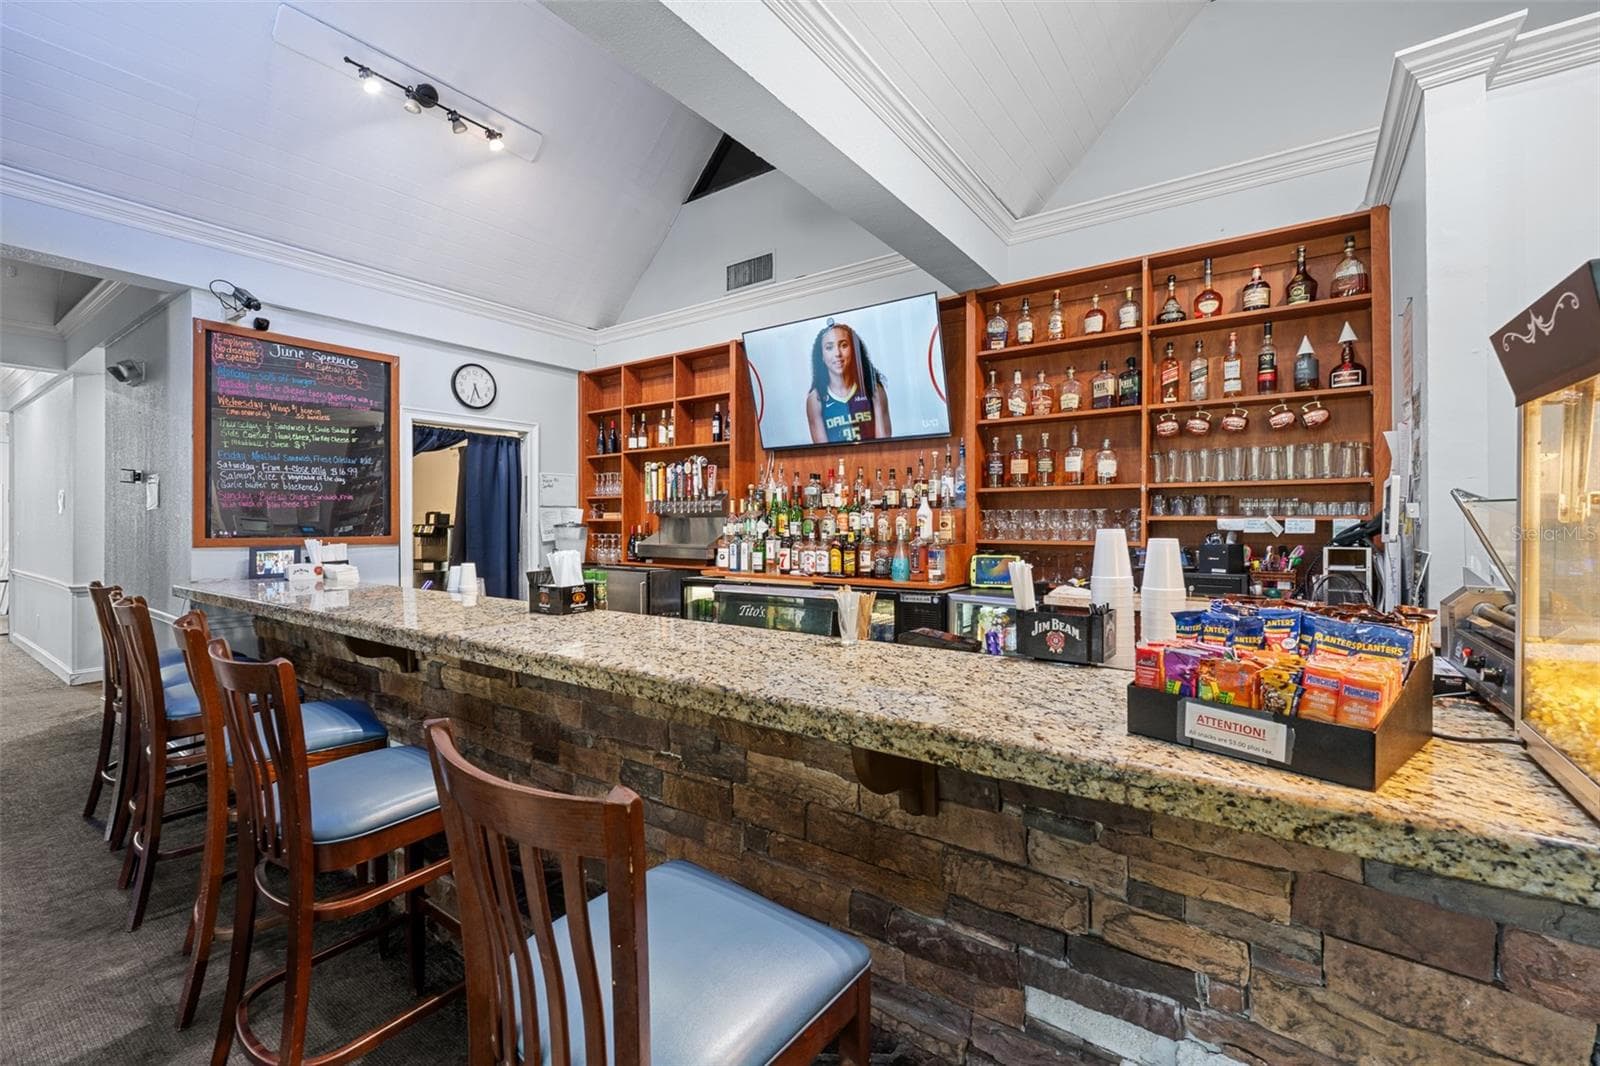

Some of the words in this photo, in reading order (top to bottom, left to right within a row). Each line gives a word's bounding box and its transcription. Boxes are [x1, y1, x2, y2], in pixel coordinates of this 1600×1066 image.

[269, 344, 305, 358] June
[311, 351, 359, 369] Specials
[304, 361, 316, 370] All
[269, 402, 291, 416] Wings
[826, 411, 872, 429] DALLAS
[220, 430, 240, 438] Side
[257, 471, 278, 480] Rice
[739, 604, 766, 618] Tito's
[1203, 625, 1230, 635] ANTERS
[1356, 641, 1406, 656] PLANTERS
[1197, 714, 1266, 739] ATTENTION!
[1197, 730, 1217, 741] snacks
[1229, 738, 1247, 748] $3.00
[1247, 742, 1260, 752] plus
